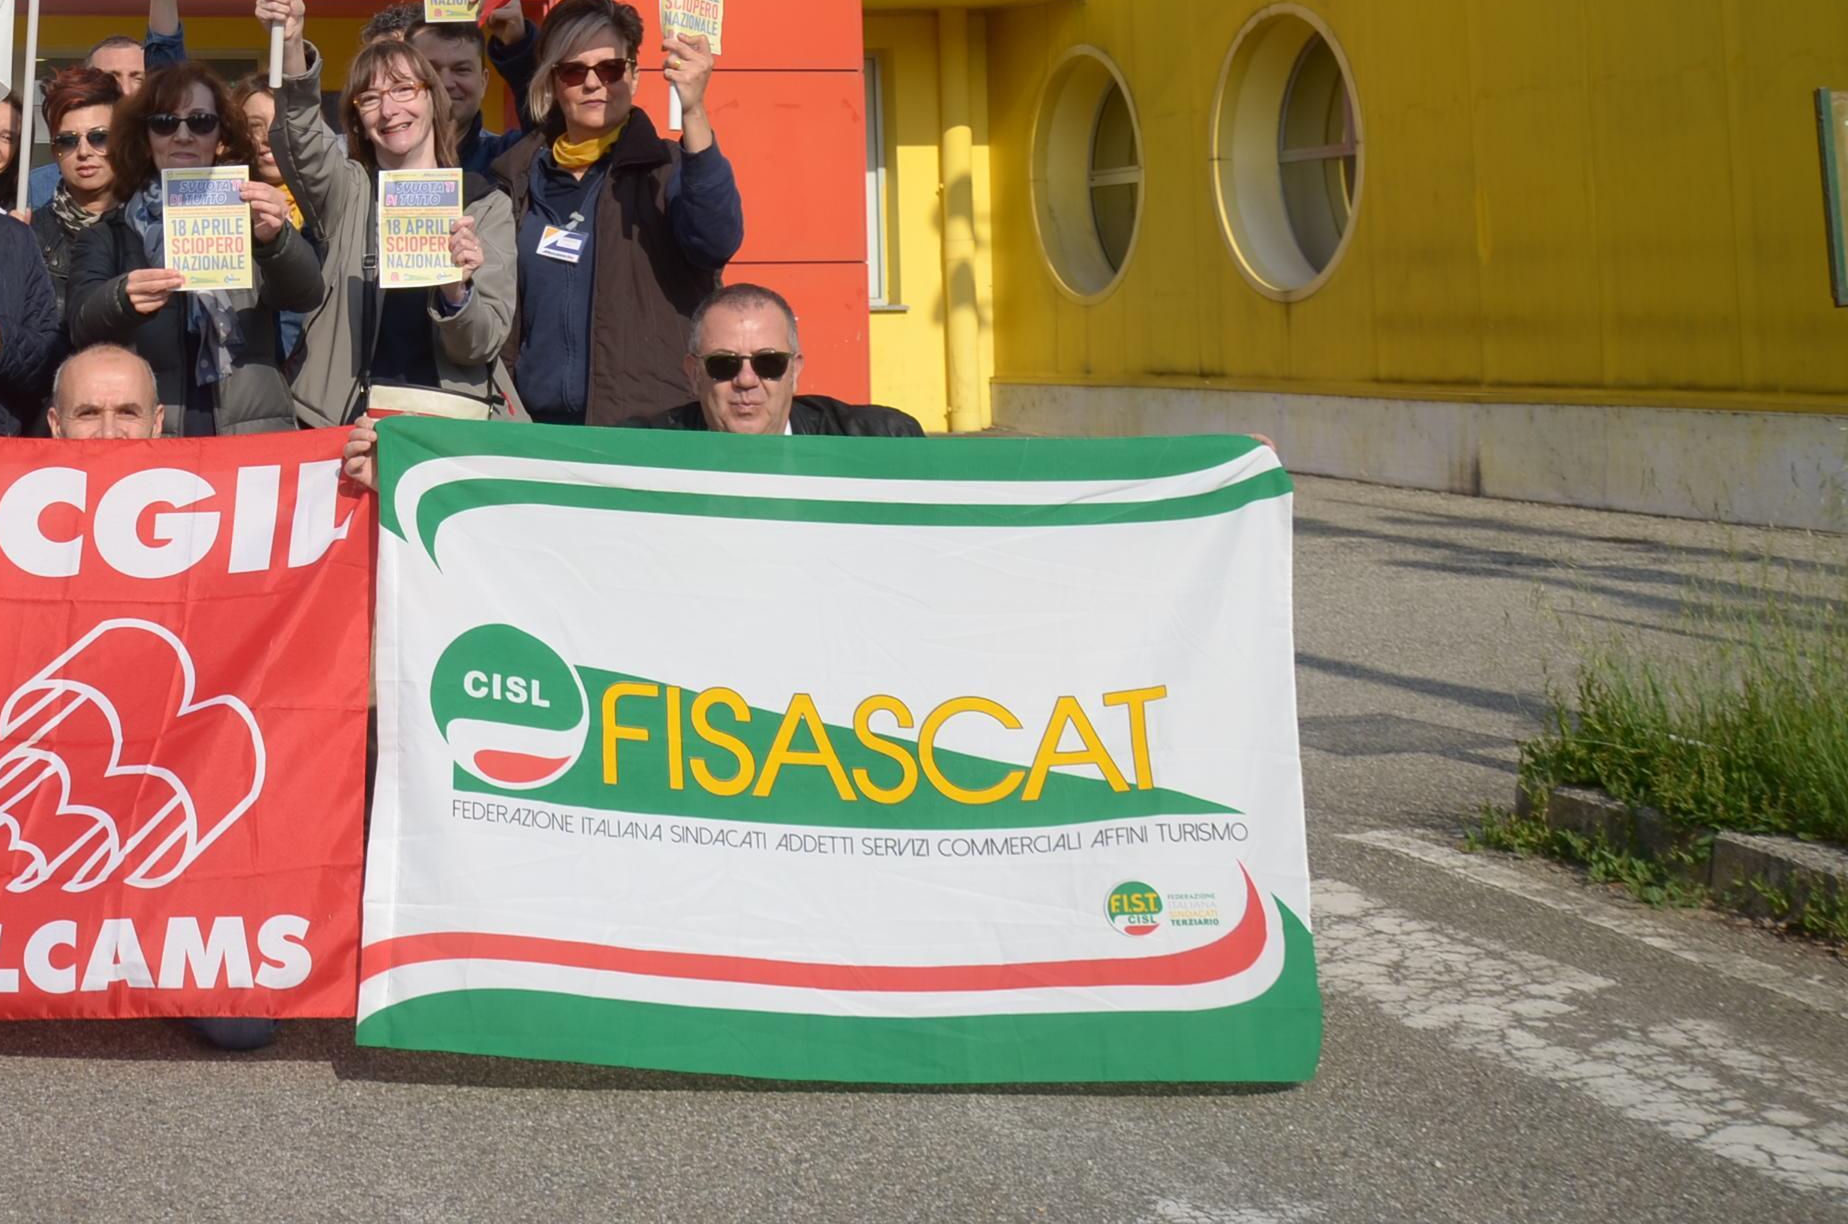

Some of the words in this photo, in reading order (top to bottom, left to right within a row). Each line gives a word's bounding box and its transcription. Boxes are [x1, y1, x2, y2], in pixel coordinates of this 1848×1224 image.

[664, 11, 718, 36] NAZIONALE
[171, 220, 186, 236] 18
[192, 218, 244, 236] APRILE
[386, 219, 401, 235] 18
[172, 237, 244, 255] SCIOPERO
[386, 236, 450, 252] SCIOPER
[172, 255, 245, 271] NAZIONALE
[463, 670, 550, 708] CISL
[600, 680, 1167, 805] FISASCAT
[452, 799, 574, 834] FEDERAZIONE
[581, 816, 662, 842] ITALIANA
[670, 825, 767, 850] SINDACATI
[775, 832, 854, 855] ADDETTI
[862, 837, 930, 857] SERVIZI
[937, 832, 1081, 857] COMMERCIALI
[1091, 825, 1148, 849] AFFINI
[1155, 822, 1249, 843] TURISMO
[1128, 915, 1157, 924] CISL
